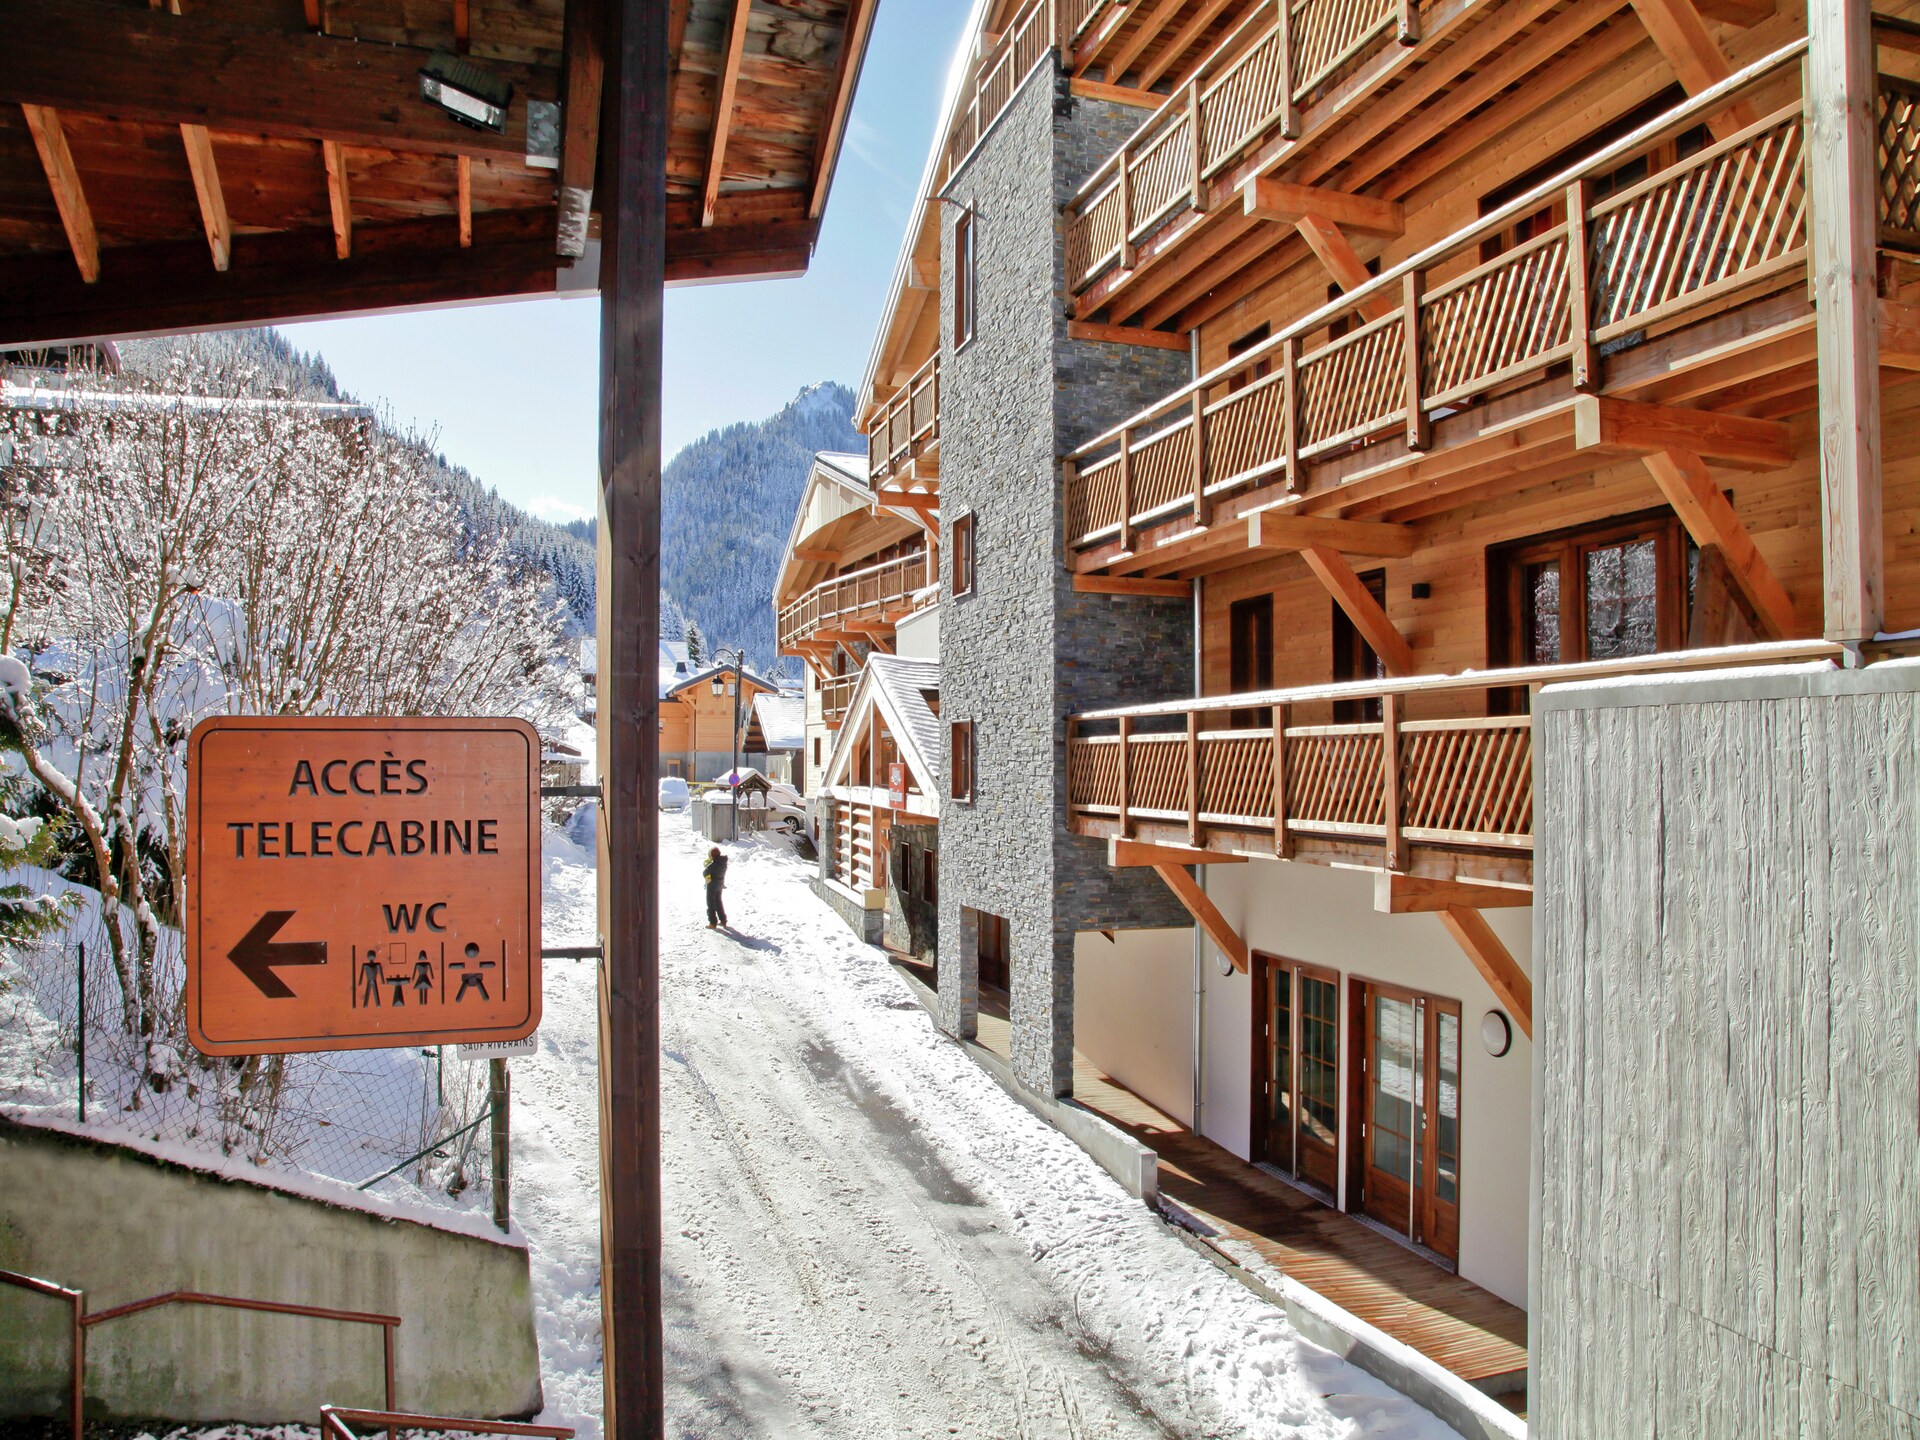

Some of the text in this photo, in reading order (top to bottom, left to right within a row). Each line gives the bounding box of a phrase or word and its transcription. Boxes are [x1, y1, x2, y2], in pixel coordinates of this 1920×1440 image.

[288, 751, 429, 797] ACCÈS
[227, 819, 499, 860] TELECABINE
[382, 902, 448, 934] WC
